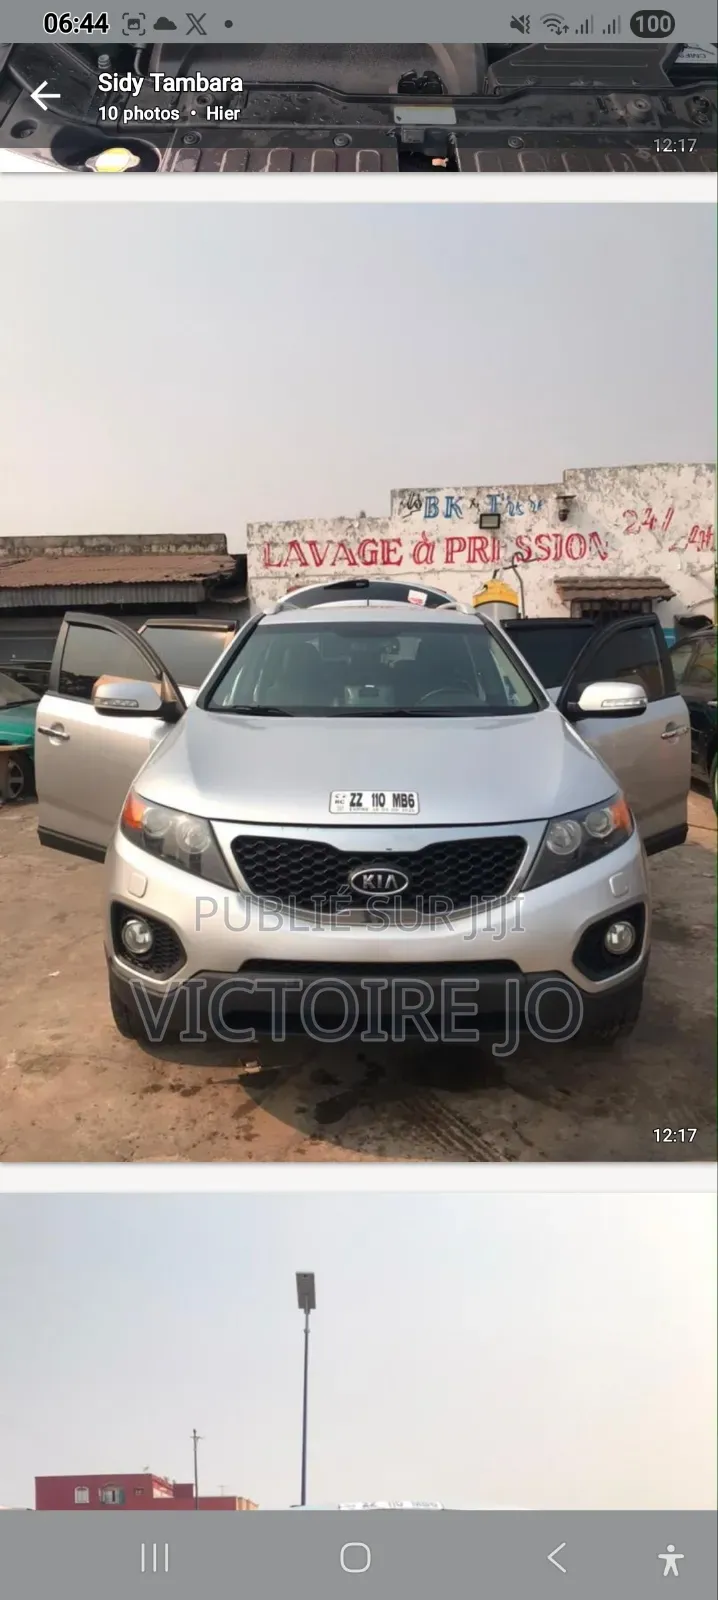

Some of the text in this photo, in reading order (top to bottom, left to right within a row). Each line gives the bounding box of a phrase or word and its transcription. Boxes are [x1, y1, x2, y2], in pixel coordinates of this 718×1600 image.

[423, 496, 463, 519] BK
[263, 537, 403, 567] LAVAGE
[349, 793, 415, 808] ZZ 110 MB6
[362, 874, 398, 889] KIA
